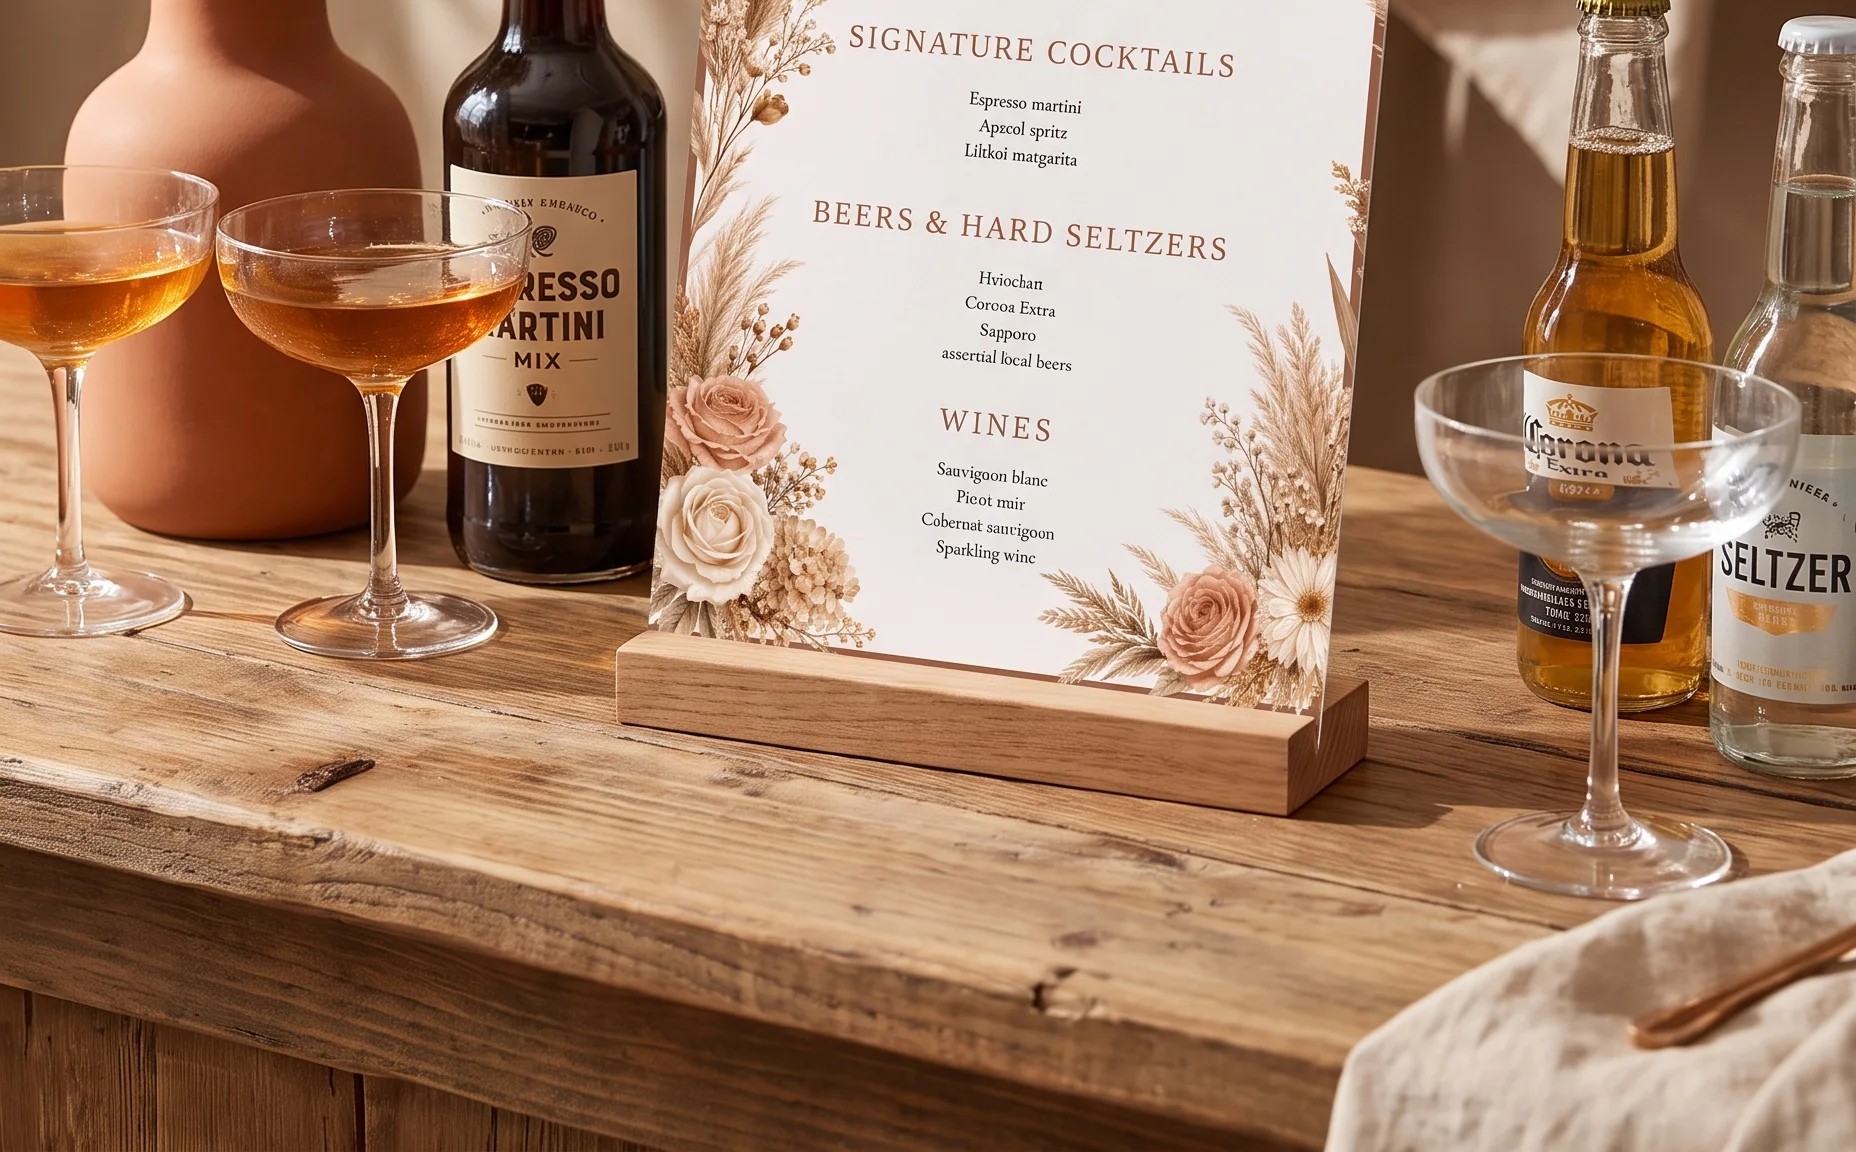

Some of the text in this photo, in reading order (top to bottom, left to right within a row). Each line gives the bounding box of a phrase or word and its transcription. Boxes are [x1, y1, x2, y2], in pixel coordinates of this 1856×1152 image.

[850, 25, 1233, 77] SIGNATURE COCKTAILS
[969, 91, 1081, 114] Espresso martini
[1030, 125, 1067, 141] spritz
[813, 200, 1225, 261] BEERS & HARD SELTZERS
[519, 268, 620, 302] RESSO
[1019, 301, 1055, 317] Extra
[488, 310, 605, 341] ARTINI
[980, 323, 1036, 343] Sapporo
[514, 352, 561, 369] MIX
[1001, 351, 1032, 367] local
[1037, 354, 1071, 371] beers
[940, 408, 1050, 441] WINES
[1525, 415, 1656, 466] Corona
[1012, 470, 1048, 487] blanc
[936, 540, 1000, 564] Sparkling
[1722, 541, 1852, 593] SELTZER
